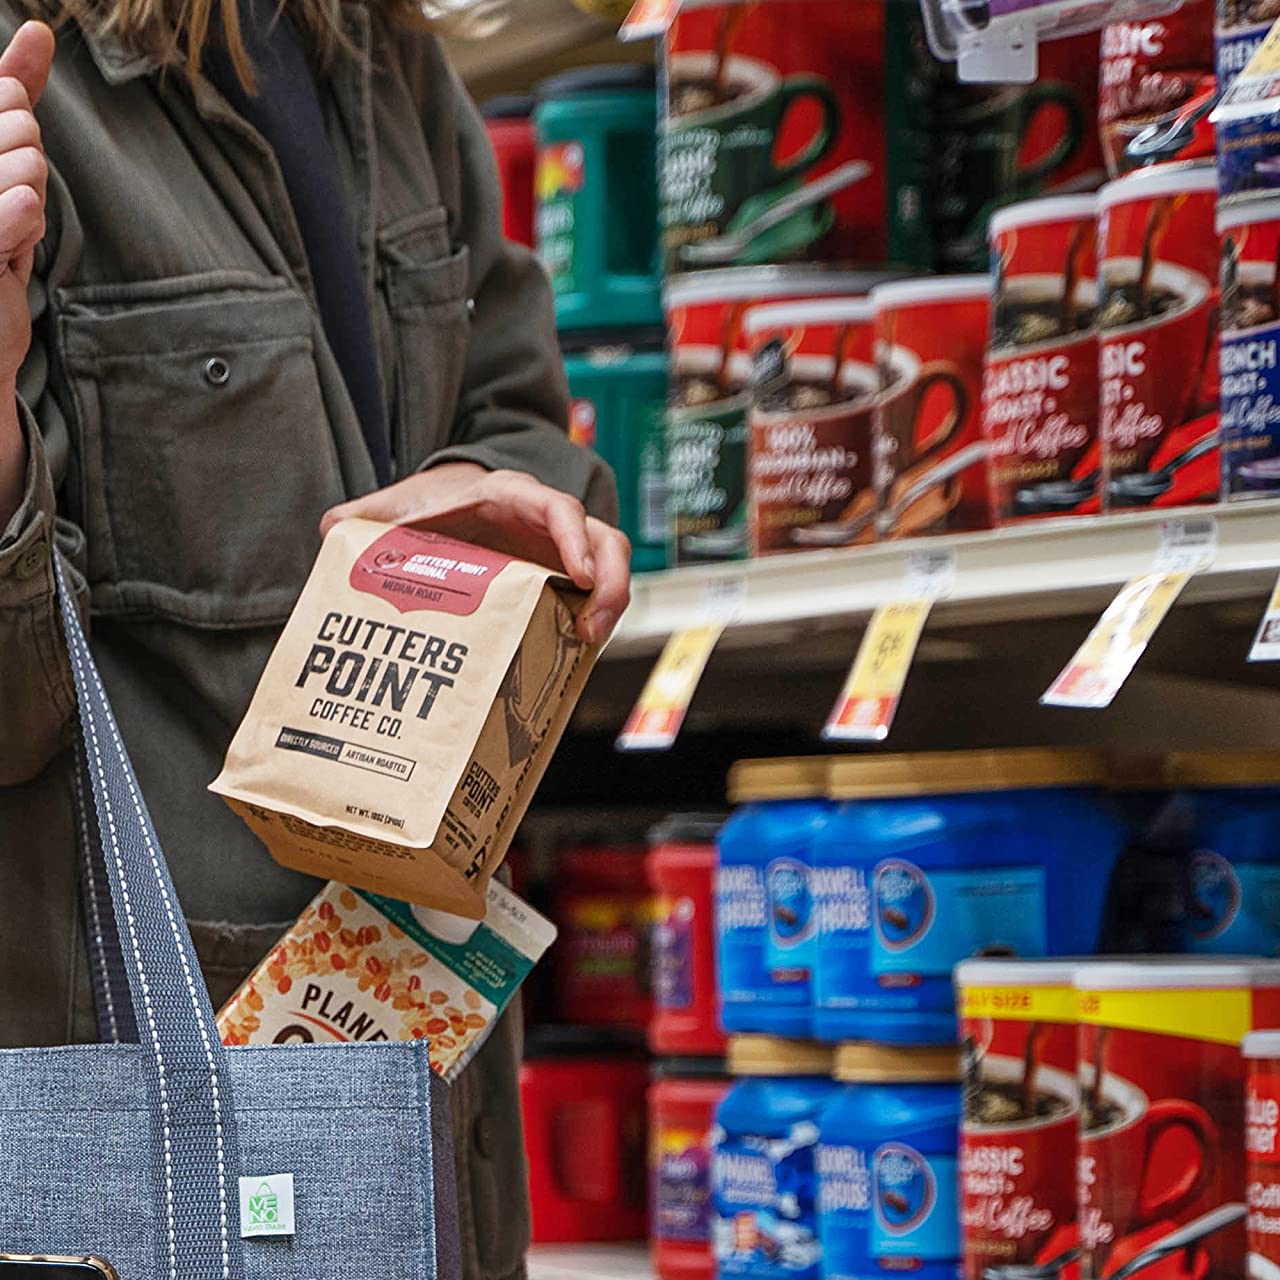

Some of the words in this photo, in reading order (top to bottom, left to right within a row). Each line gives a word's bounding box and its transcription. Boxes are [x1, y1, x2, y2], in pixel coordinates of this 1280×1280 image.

[402, 561, 448, 580] ORIGINAL
[455, 561, 488, 577] POINT
[415, 587, 443, 602] ROAST
[317, 612, 469, 675] CUTTERS
[295, 643, 455, 720] POINT
[309, 698, 375, 731] COFFEE
[376, 715, 403, 740] CO.
[345, 749, 375, 765] ARTISAN
[375, 758, 408, 774] ROASTED
[460, 772, 496, 814] POINT
